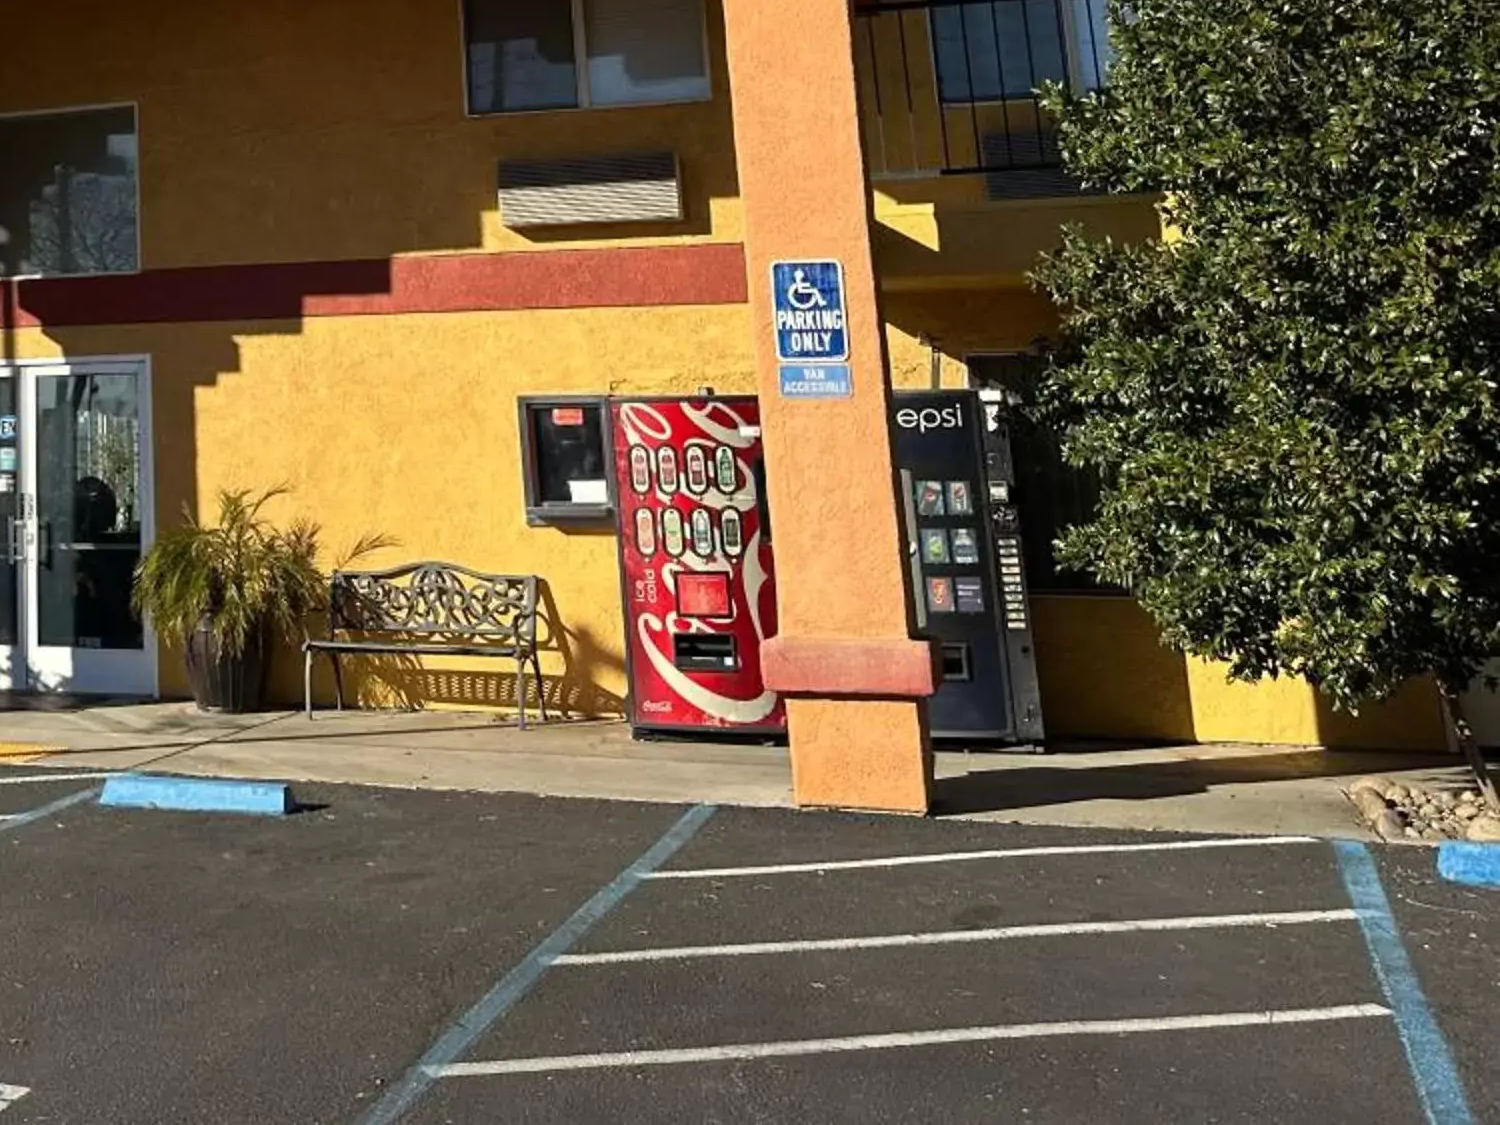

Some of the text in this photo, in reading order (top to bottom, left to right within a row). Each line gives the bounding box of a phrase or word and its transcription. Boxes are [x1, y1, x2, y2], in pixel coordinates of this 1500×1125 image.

[778, 311, 841, 329] PARKING
[791, 333, 832, 352] ONLY
[896, 403, 963, 434] epsi
